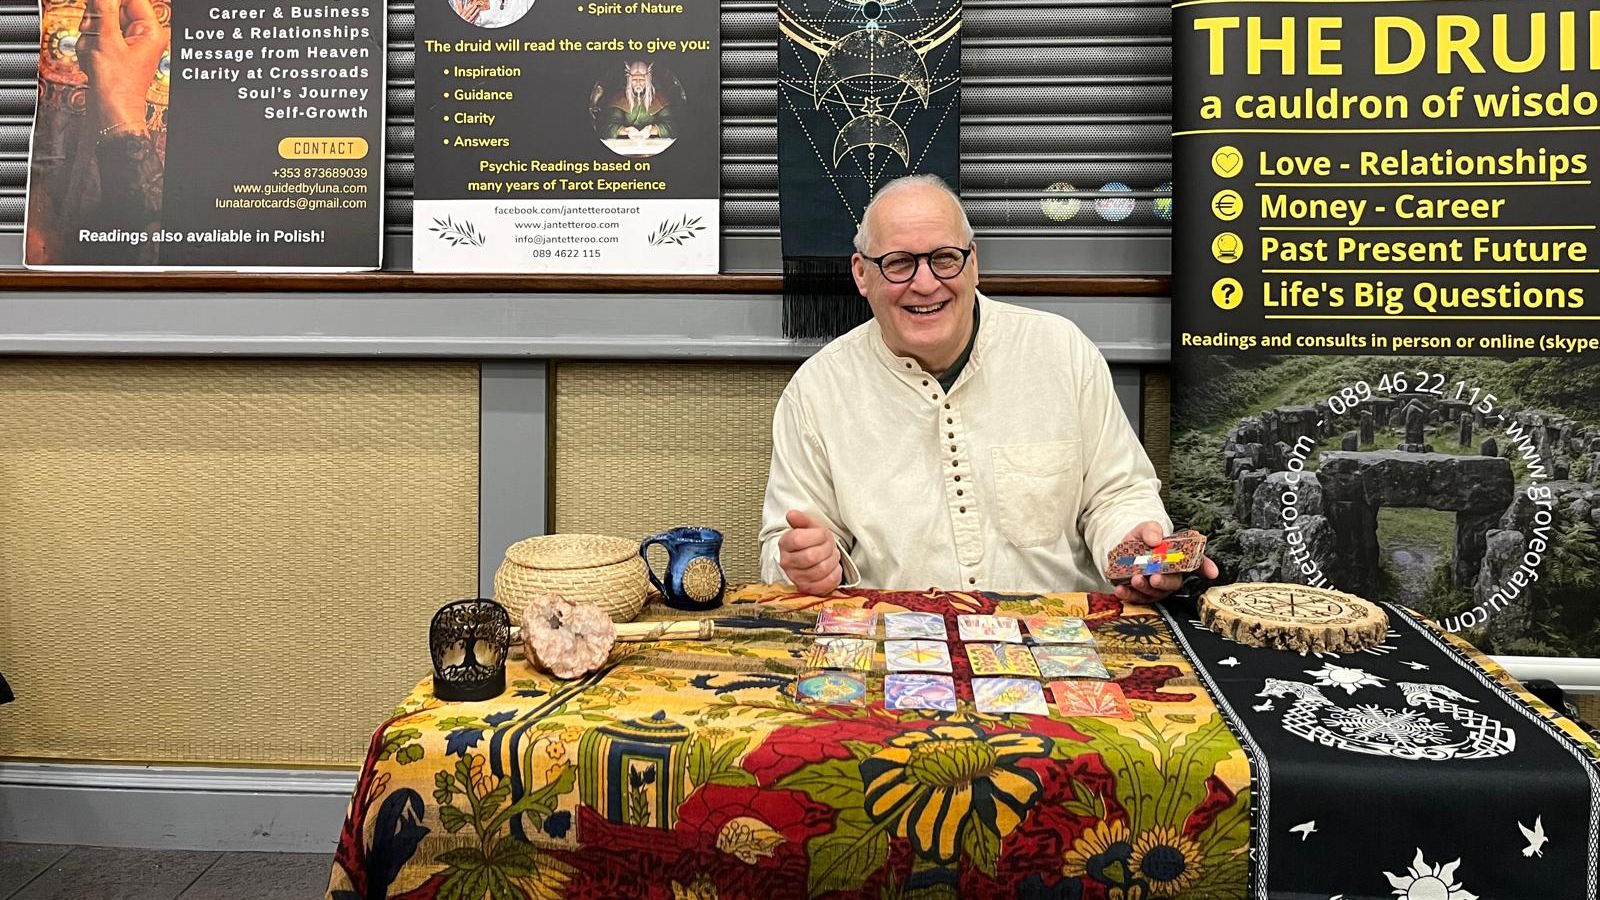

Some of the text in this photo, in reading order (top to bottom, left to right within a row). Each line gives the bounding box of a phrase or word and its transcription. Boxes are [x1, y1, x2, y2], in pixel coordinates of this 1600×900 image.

[210, 6, 369, 19] Career & Business
[589, 3, 683, 16] Spirit of Nature
[185, 26, 369, 40] Love & Relationships
[425, 38, 709, 53] The druid will read the cards to give you:
[1194, 11, 1600, 75] THE DRUI
[181, 47, 368, 62] Message from Heaven
[182, 66, 368, 82] Clarity at Crossroads
[455, 66, 520, 79] Inspiration
[299, 87, 368, 100] Journey
[455, 89, 512, 100] Guidance
[1200, 84, 1597, 119] a cauldron of wisdo
[265, 106, 367, 118] Self-Growth
[455, 112, 495, 125] Clarity
[454, 136, 509, 146] Answers
[294, 142, 353, 154] CONTACT
[480, 161, 527, 173] Psychic
[531, 160, 589, 173] Readings
[594, 160, 630, 171] based
[1260, 152, 1330, 175] Love
[1361, 148, 1589, 182] Relationships
[273, 168, 367, 178] +353 873689039
[234, 183, 367, 195] www.guidedbyluna.com
[468, 179, 665, 192] many years of Tarot Experience
[216, 198, 366, 210] lunatarotcards@gmail.com
[495, 206, 639, 215] facebook.com/jantetterootarot
[1262, 195, 1366, 225] Money
[1396, 194, 1505, 218] Career
[515, 221, 619, 230] www.jantetteroo.com
[79, 229, 324, 245] Readings also avaliable in Polish!
[516, 235, 618, 244] info@jantetteroo.com
[1262, 238, 1586, 261] Past Present Future
[1264, 281, 1583, 314] Life's Big Questions
[1183, 333, 1256, 350] Readings
[1261, 333, 1291, 346] and
[1297, 333, 1366, 347] consults
[1372, 334, 1387, 347] in
[1393, 337, 1451, 351] person
[1457, 338, 1475, 347] or
[1480, 335, 1534, 348] online
[1282, 435, 1335, 591] tetteroo.com
[1328, 381, 1371, 415] 089
[1378, 374, 1408, 393] 46
[1415, 372, 1446, 395] 22
[1455, 381, 1497, 414] 115
